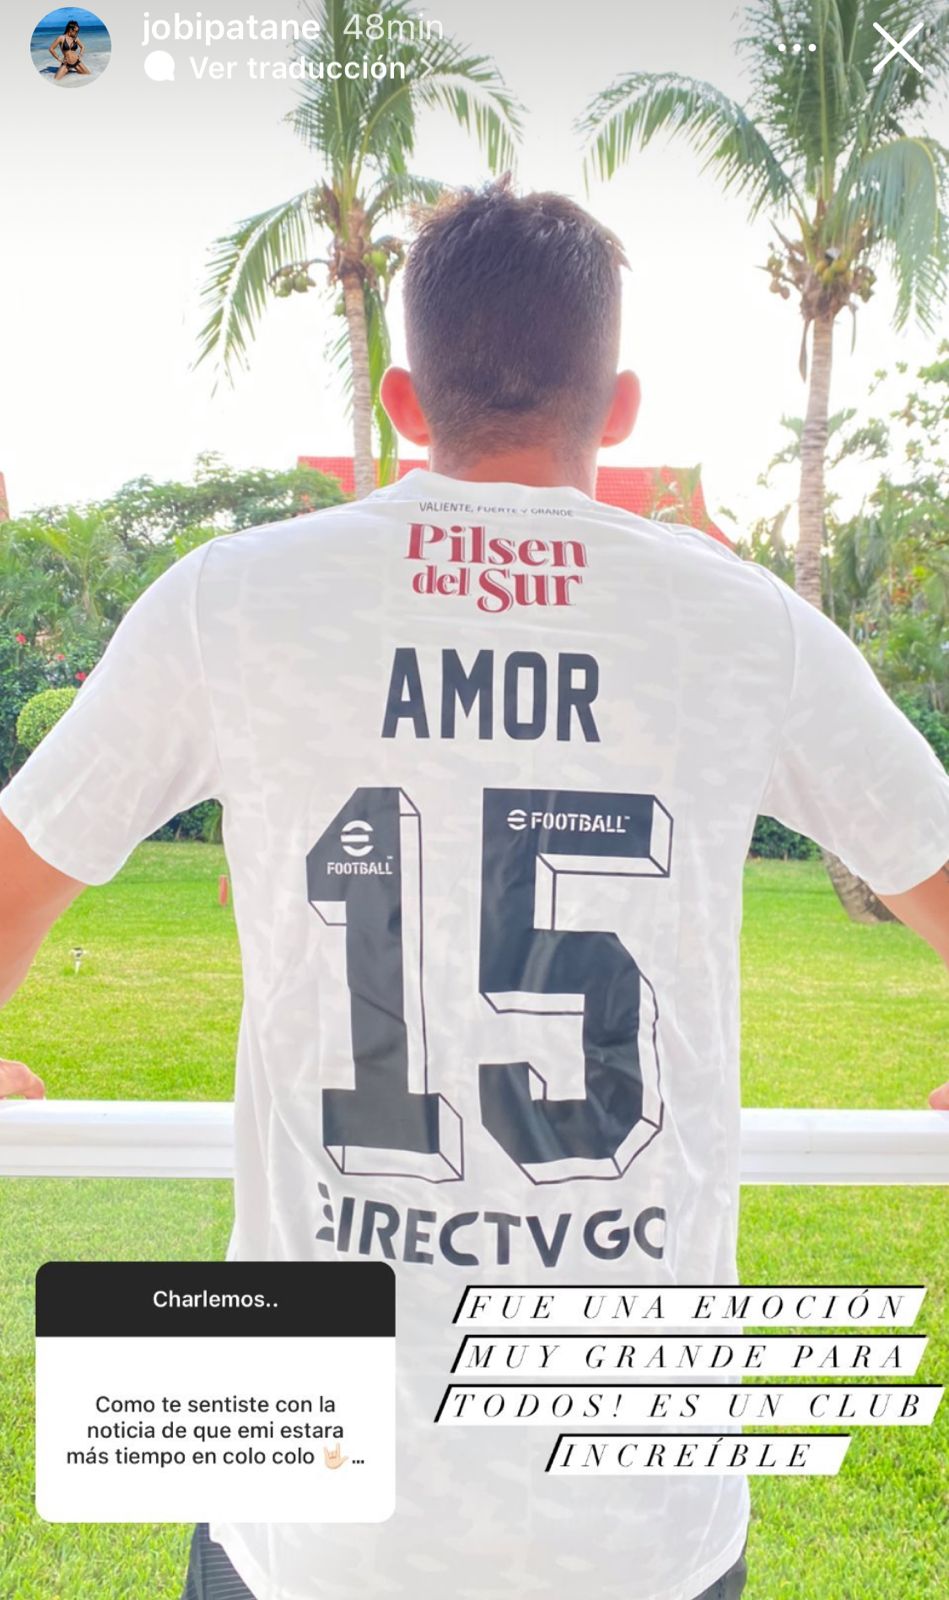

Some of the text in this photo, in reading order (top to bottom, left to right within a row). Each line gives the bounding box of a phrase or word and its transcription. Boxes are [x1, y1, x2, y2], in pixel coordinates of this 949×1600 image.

[419, 502, 474, 513] VALIENTE,
[403, 522, 588, 568] Pilsen
[412, 565, 583, 613] del Sur
[381, 648, 600, 742] AMOR
[306, 787, 674, 1185] 15
